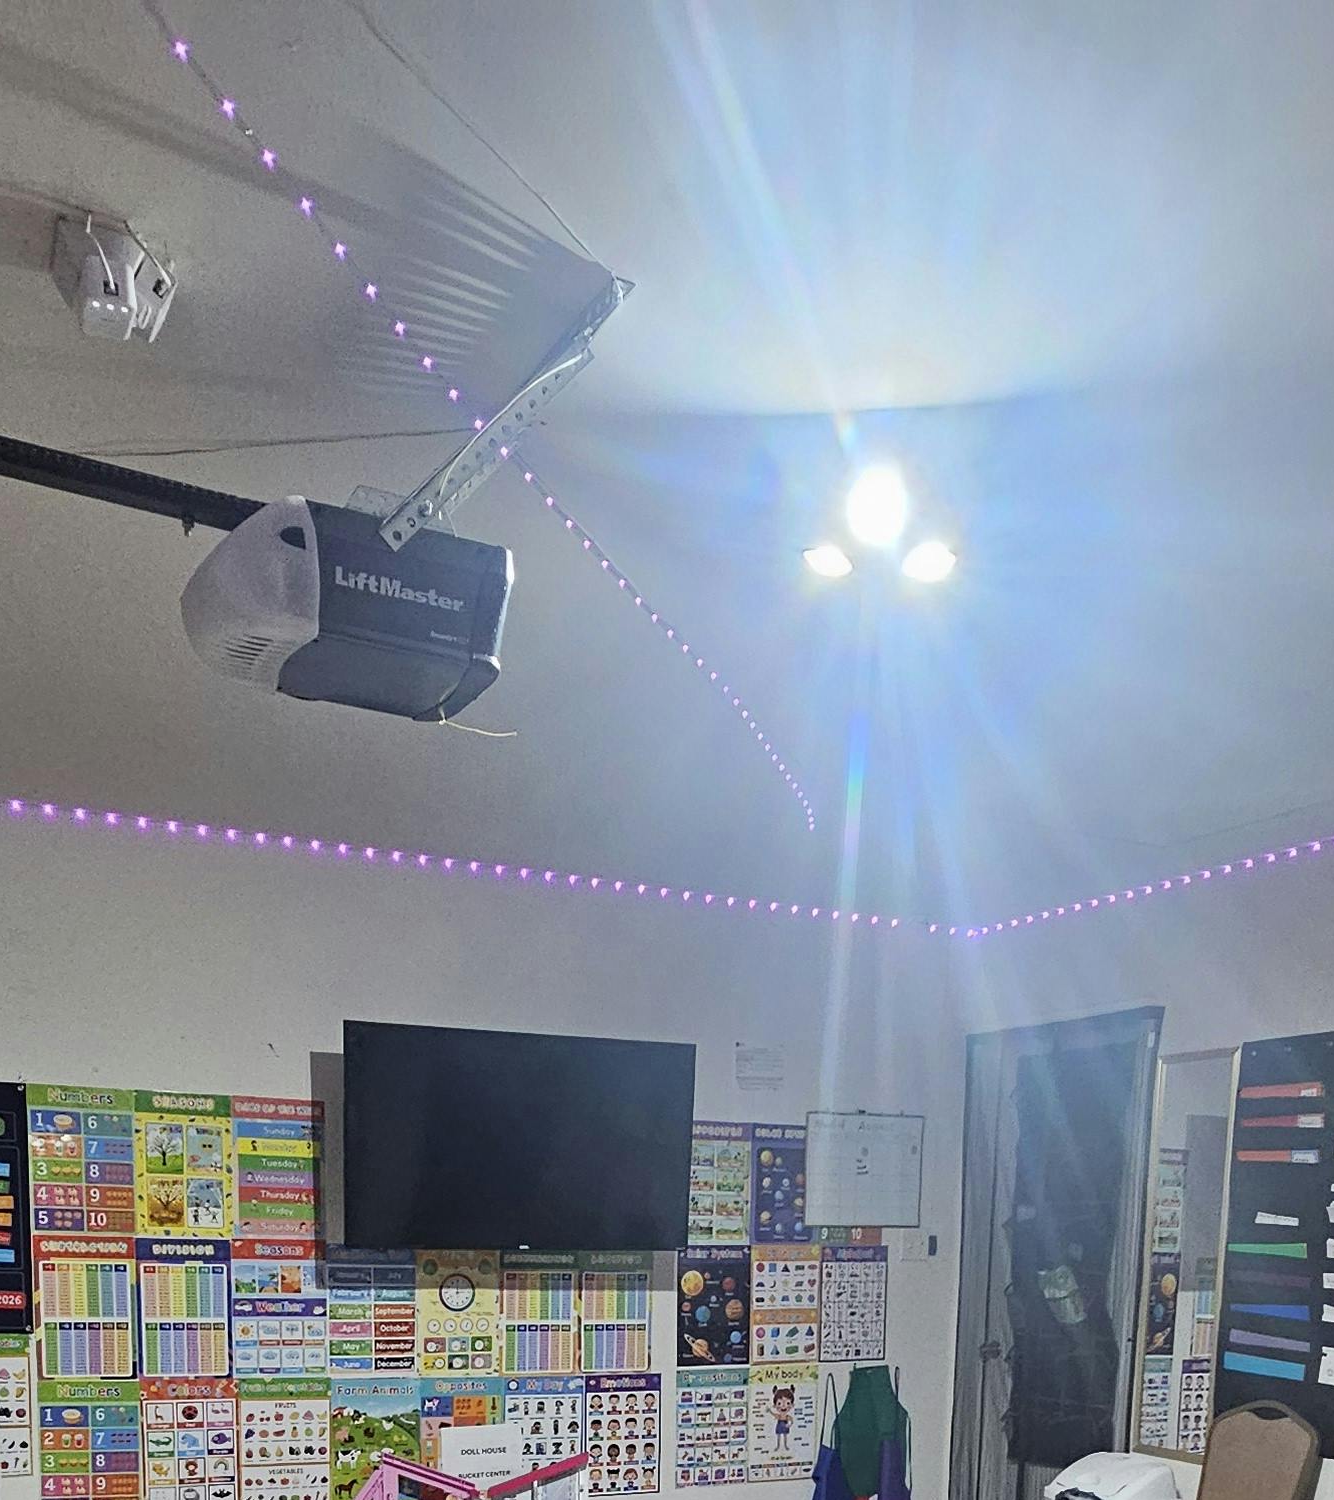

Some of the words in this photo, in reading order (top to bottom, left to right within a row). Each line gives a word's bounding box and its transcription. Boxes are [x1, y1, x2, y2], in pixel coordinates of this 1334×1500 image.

[335, 566, 465, 612] LiftMaster
[48, 1088, 113, 1104] Numbers
[263, 1127, 295, 1136] Sunday
[262, 1159, 297, 1169] Tuesday
[254, 1174, 305, 1185] Wednesday
[260, 1190, 299, 1200] Thursday
[255, 1243, 304, 1256] Seasons
[256, 1302, 305, 1313] Weather
[375, 1307, 413, 1316] September
[376, 1342, 413, 1350] November
[377, 1360, 412, 1368] December
[765, 1370, 780, 1380] My
[781, 1370, 804, 1382] body
[338, 1386, 367, 1395] Farm
[372, 1385, 413, 1394] Animals
[435, 1381, 487, 1391] Opposites
[58, 1385, 120, 1398] Numbers
[461, 1448, 479, 1456] DOLL
[486, 1470, 510, 1478] CENTER
